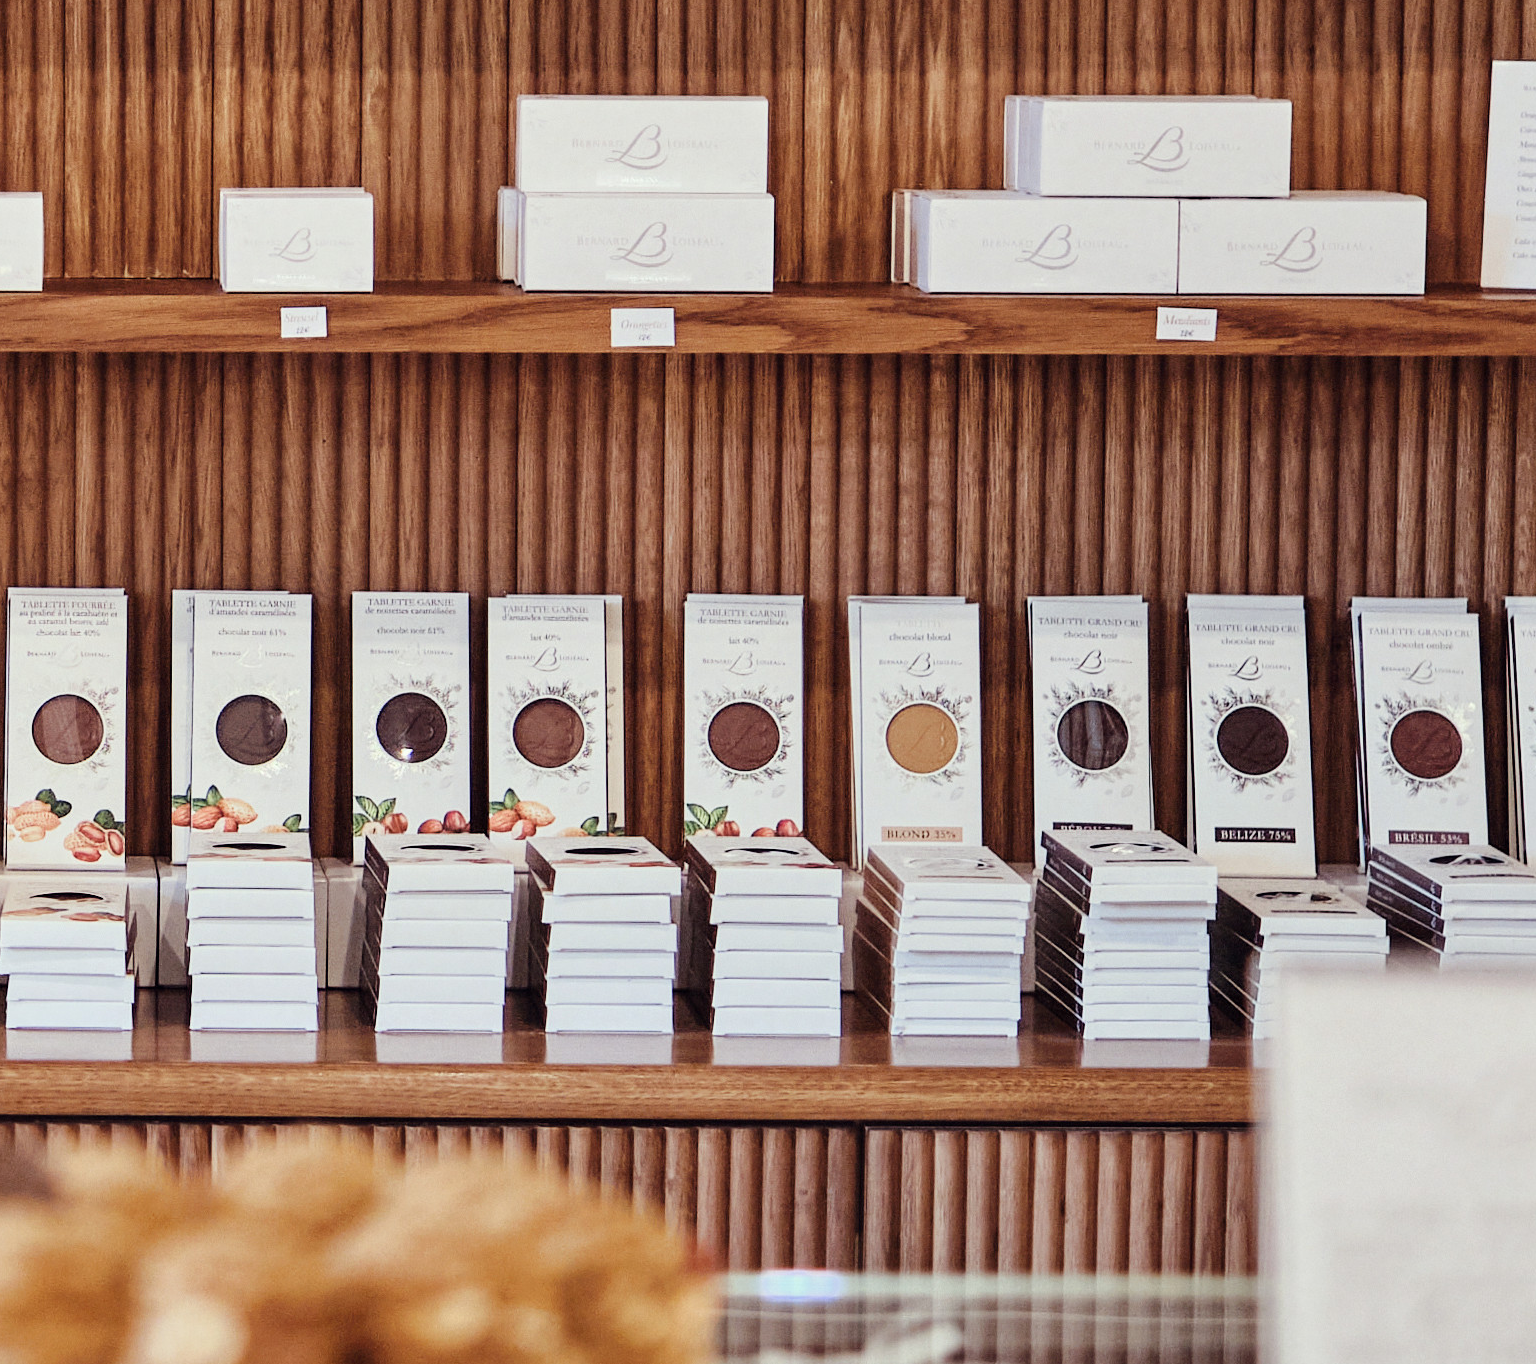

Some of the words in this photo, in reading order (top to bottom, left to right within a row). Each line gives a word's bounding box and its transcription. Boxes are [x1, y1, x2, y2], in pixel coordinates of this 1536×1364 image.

[572, 138, 624, 148] BERNARD
[667, 138, 712, 148] LOISEAU
[1093, 141, 1146, 151] BERNARD
[1189, 141, 1232, 151] LOISEAU
[577, 236, 629, 246] BERNARD
[672, 237, 717, 247] LOISEAU
[982, 238, 1034, 248] BERNARD
[1227, 242, 1278, 251] BERNARD
[21, 601, 69, 609] TABLETTE
[209, 600, 257, 608] TABLETTE
[368, 598, 415, 606] TABLETTE
[417, 599, 454, 607] GARNIE
[503, 605, 550, 613] TABLETTE
[749, 609, 786, 617] GARNIE
[1038, 617, 1085, 625] TABLETTE
[1087, 618, 1122, 626] GRAND
[1124, 619, 1143, 627] CRU
[1195, 624, 1242, 632] TABLETTE
[1281, 625, 1299, 633] CRU
[1369, 627, 1417, 635] TABLETTE
[1418, 629, 1452, 637] GRAND
[889, 632, 924, 641] chocolat
[927, 632, 951, 641] blond
[1064, 631, 1099, 639] chocolat
[1221, 637, 1255, 645] chocolat
[1389, 639, 1424, 648] chocolat
[887, 829, 930, 839] BLOND
[1220, 829, 1266, 840] BELIZE
[1268, 830, 1291, 841] 75%
[1394, 830, 1437, 843] BRÉSIL
